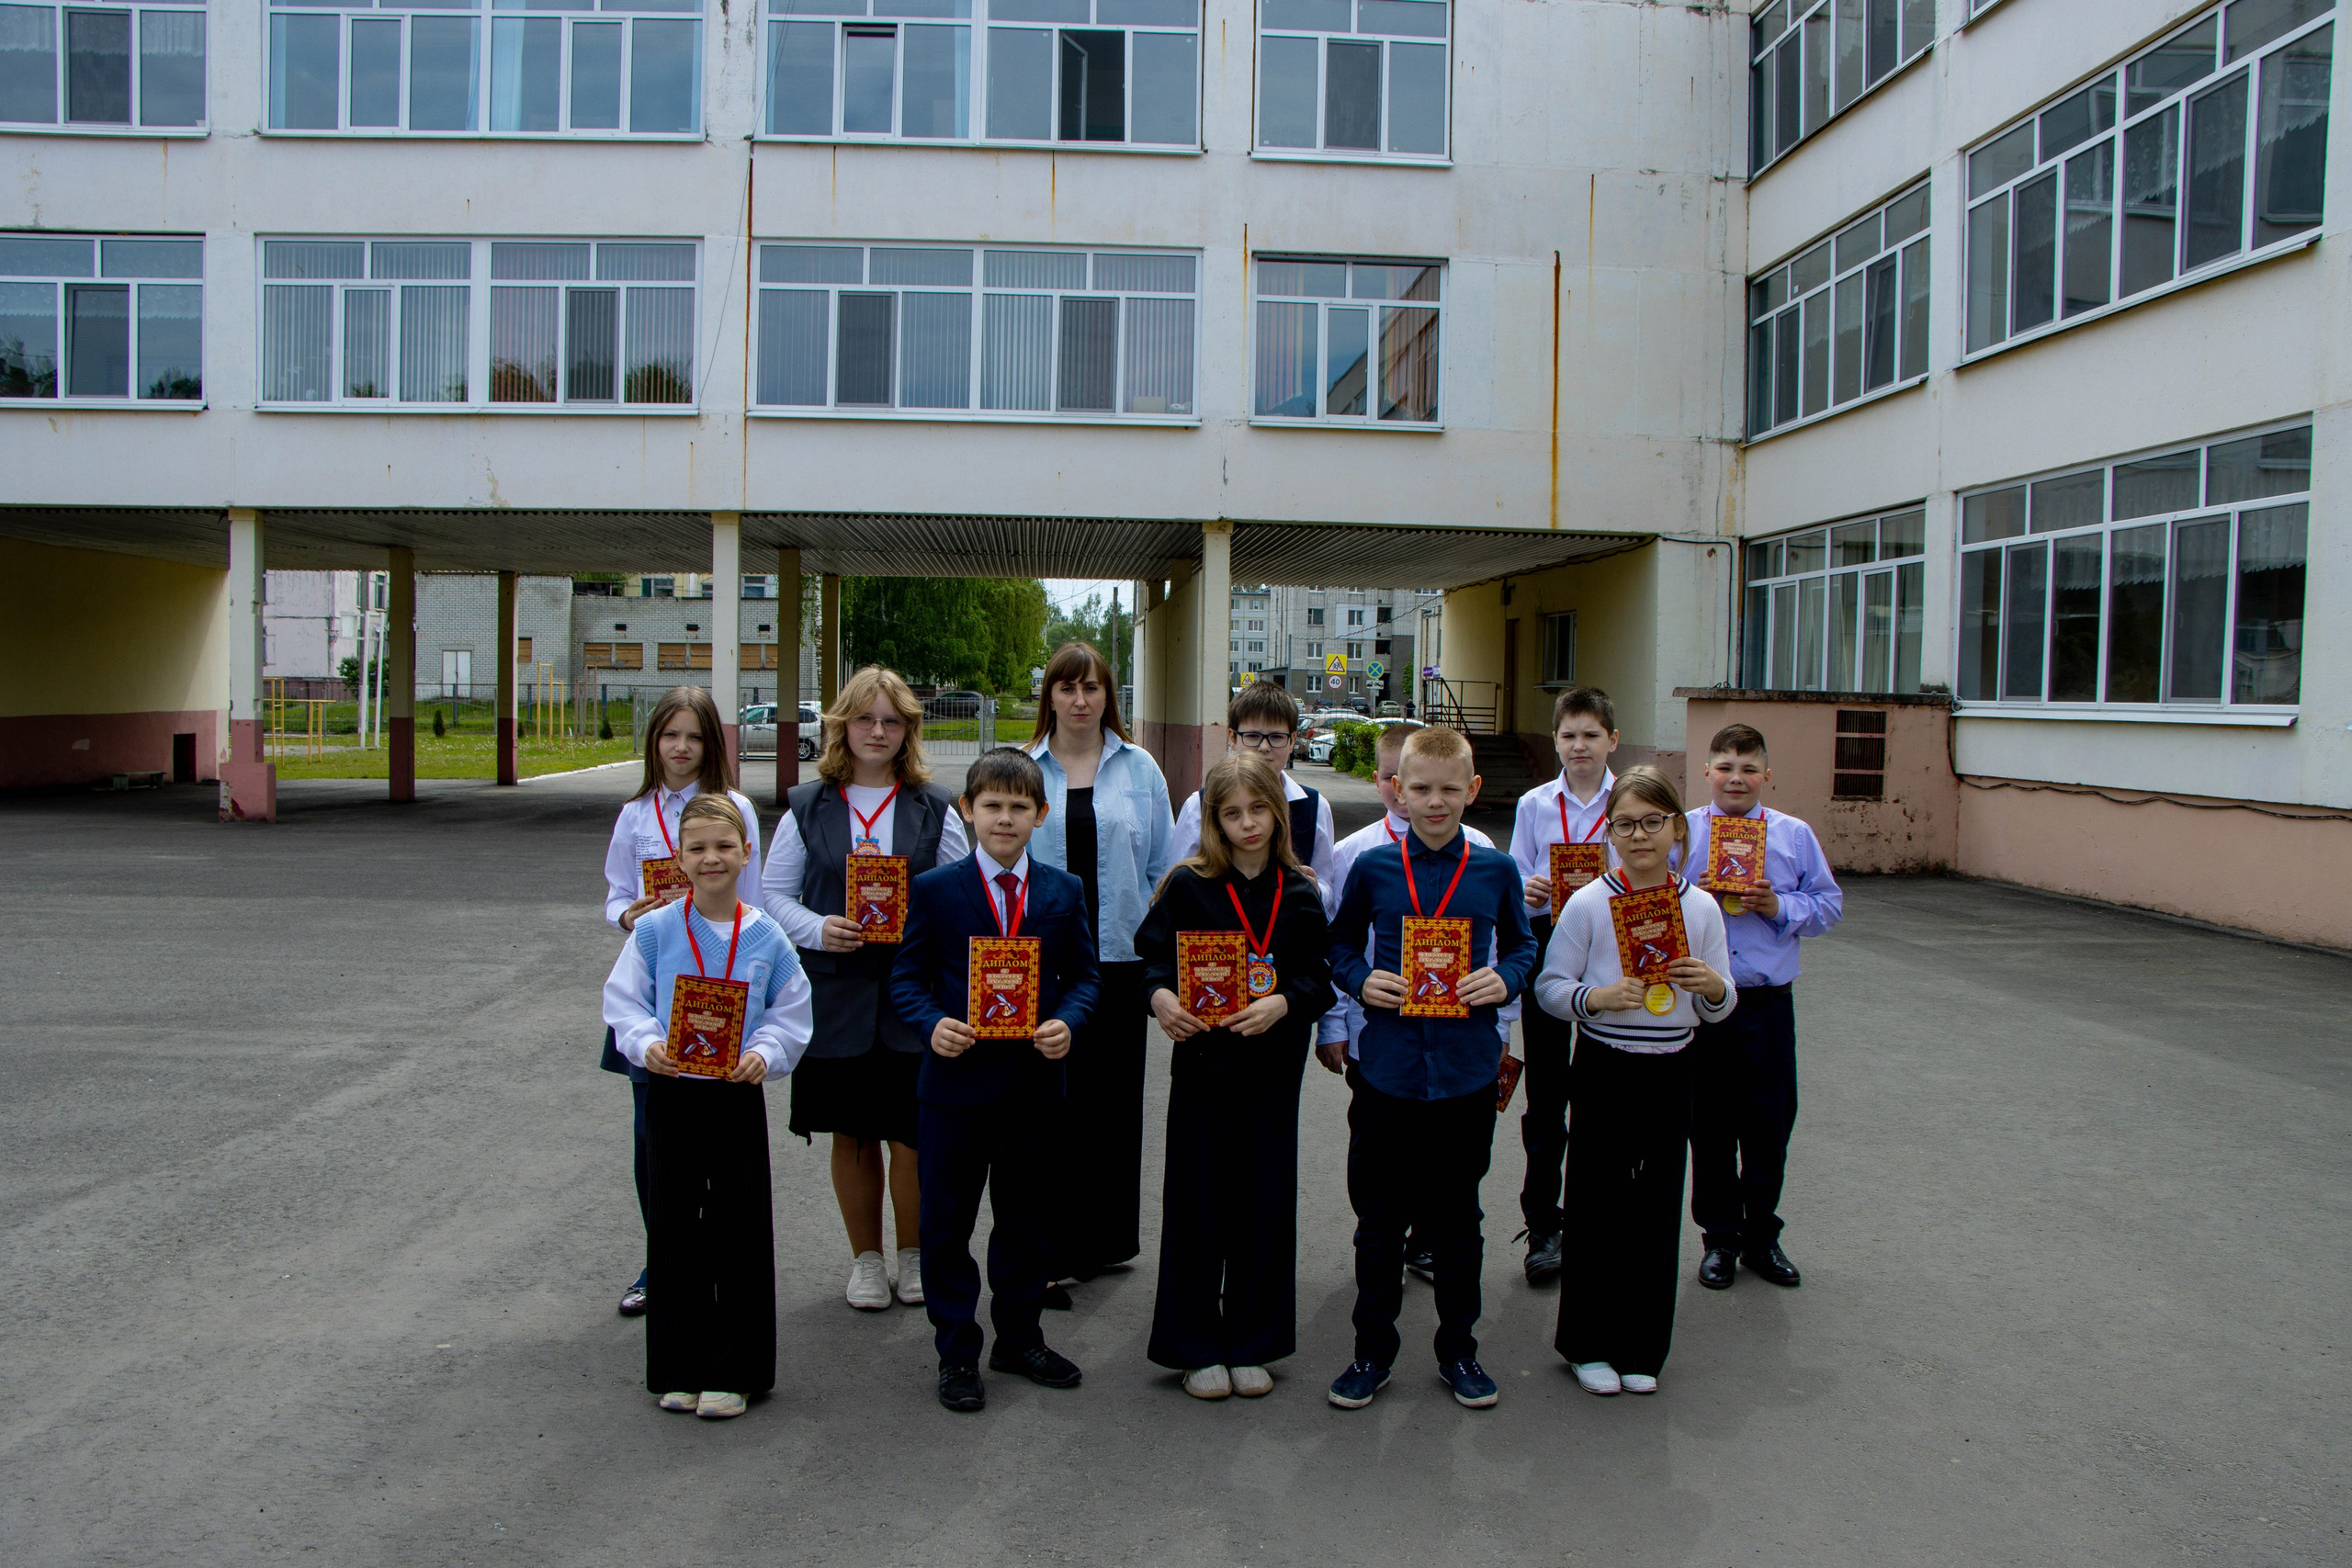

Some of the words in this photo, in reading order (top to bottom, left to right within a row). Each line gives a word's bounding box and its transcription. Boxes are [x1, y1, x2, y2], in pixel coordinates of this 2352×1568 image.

[1720, 831, 1757, 840] ДИПЛОМ
[1559, 861, 1598, 869] ДИПЛОМ
[654, 875, 690, 886] ДИПЛО
[1625, 907, 1670, 923] ДИПЛОМ
[1414, 939, 1460, 947] ДИПЛОМ
[1190, 953, 1237, 963] ДИПЛОМ
[982, 959, 1029, 968] ДИПЛОМ
[684, 999, 733, 1013] ДИПЛОМ
